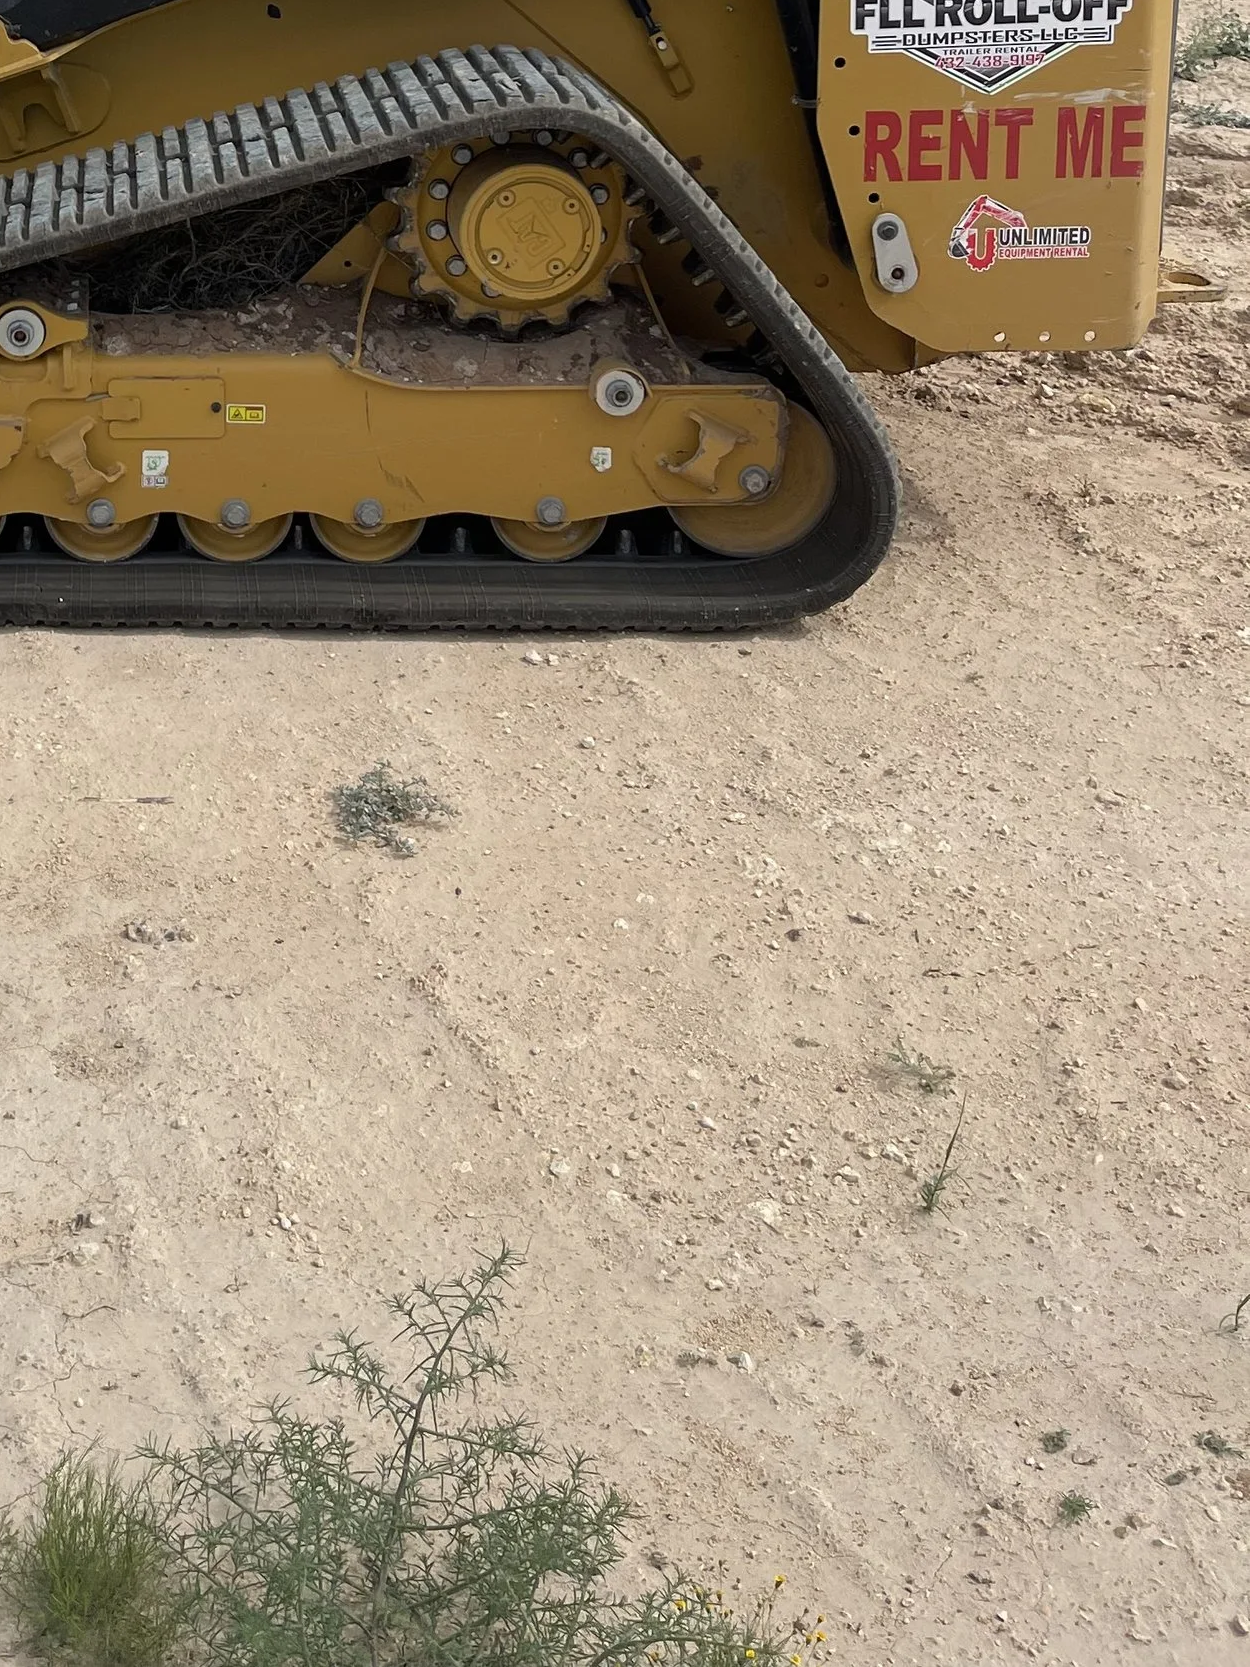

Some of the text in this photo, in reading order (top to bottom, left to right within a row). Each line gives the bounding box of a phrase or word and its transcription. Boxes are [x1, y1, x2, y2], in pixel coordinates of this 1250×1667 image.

[902, 26, 1079, 47] DUMPSTERS LLC
[943, 45, 1040, 56] TRAILER RENTAL
[934, 53, 1045, 69] 432-438-9197
[863, 105, 1146, 182] RENT ME
[999, 227, 1090, 246] UNLIMITED
[999, 246, 1089, 258] EQUIPMENT RENTAL
